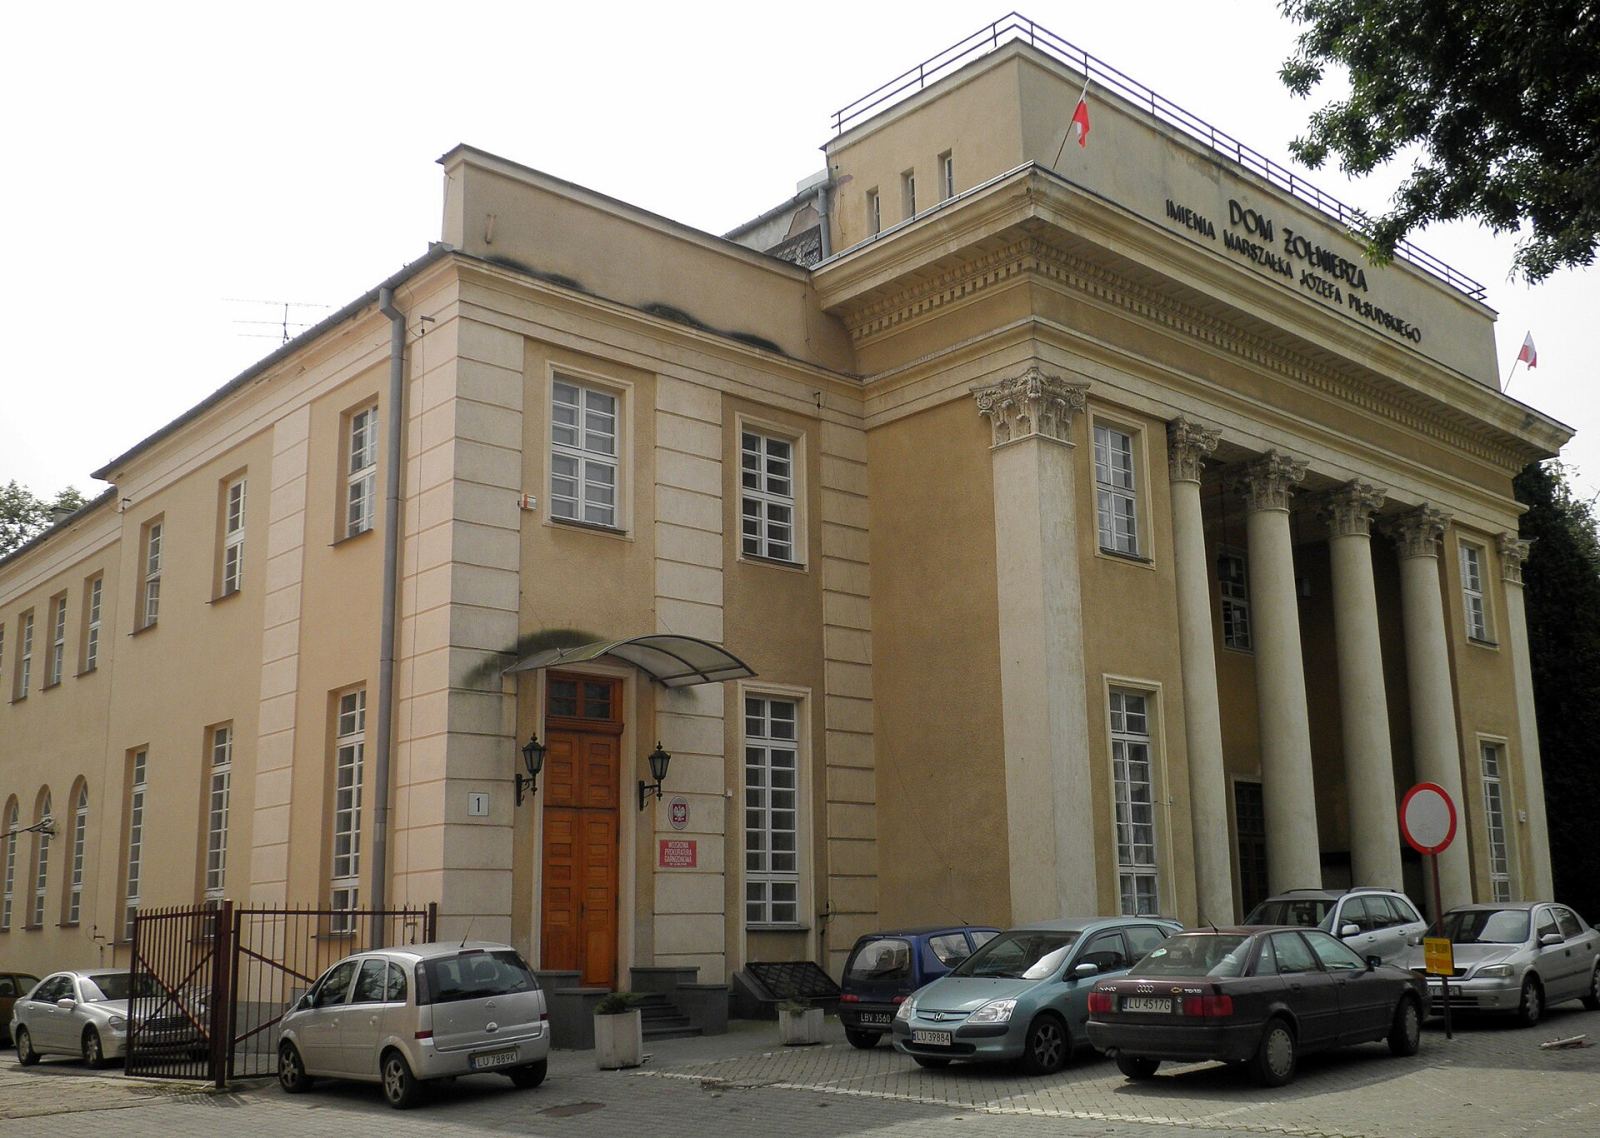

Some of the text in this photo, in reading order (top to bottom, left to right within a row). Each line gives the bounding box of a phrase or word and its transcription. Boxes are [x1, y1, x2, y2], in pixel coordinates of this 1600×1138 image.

[1229, 199, 1368, 292] DOM ŻOŁNIERZA
[1166, 198, 1216, 240] IMIENIA
[1223, 229, 1293, 279] MARSZAŁKA
[1348, 293, 1421, 343] PIŁSUDSKIEGO
[476, 797, 481, 813] 1
[1129, 998, 1170, 1010] LU 4517G
[917, 1031, 927, 1041] LU
[477, 1056, 490, 1067] LU
